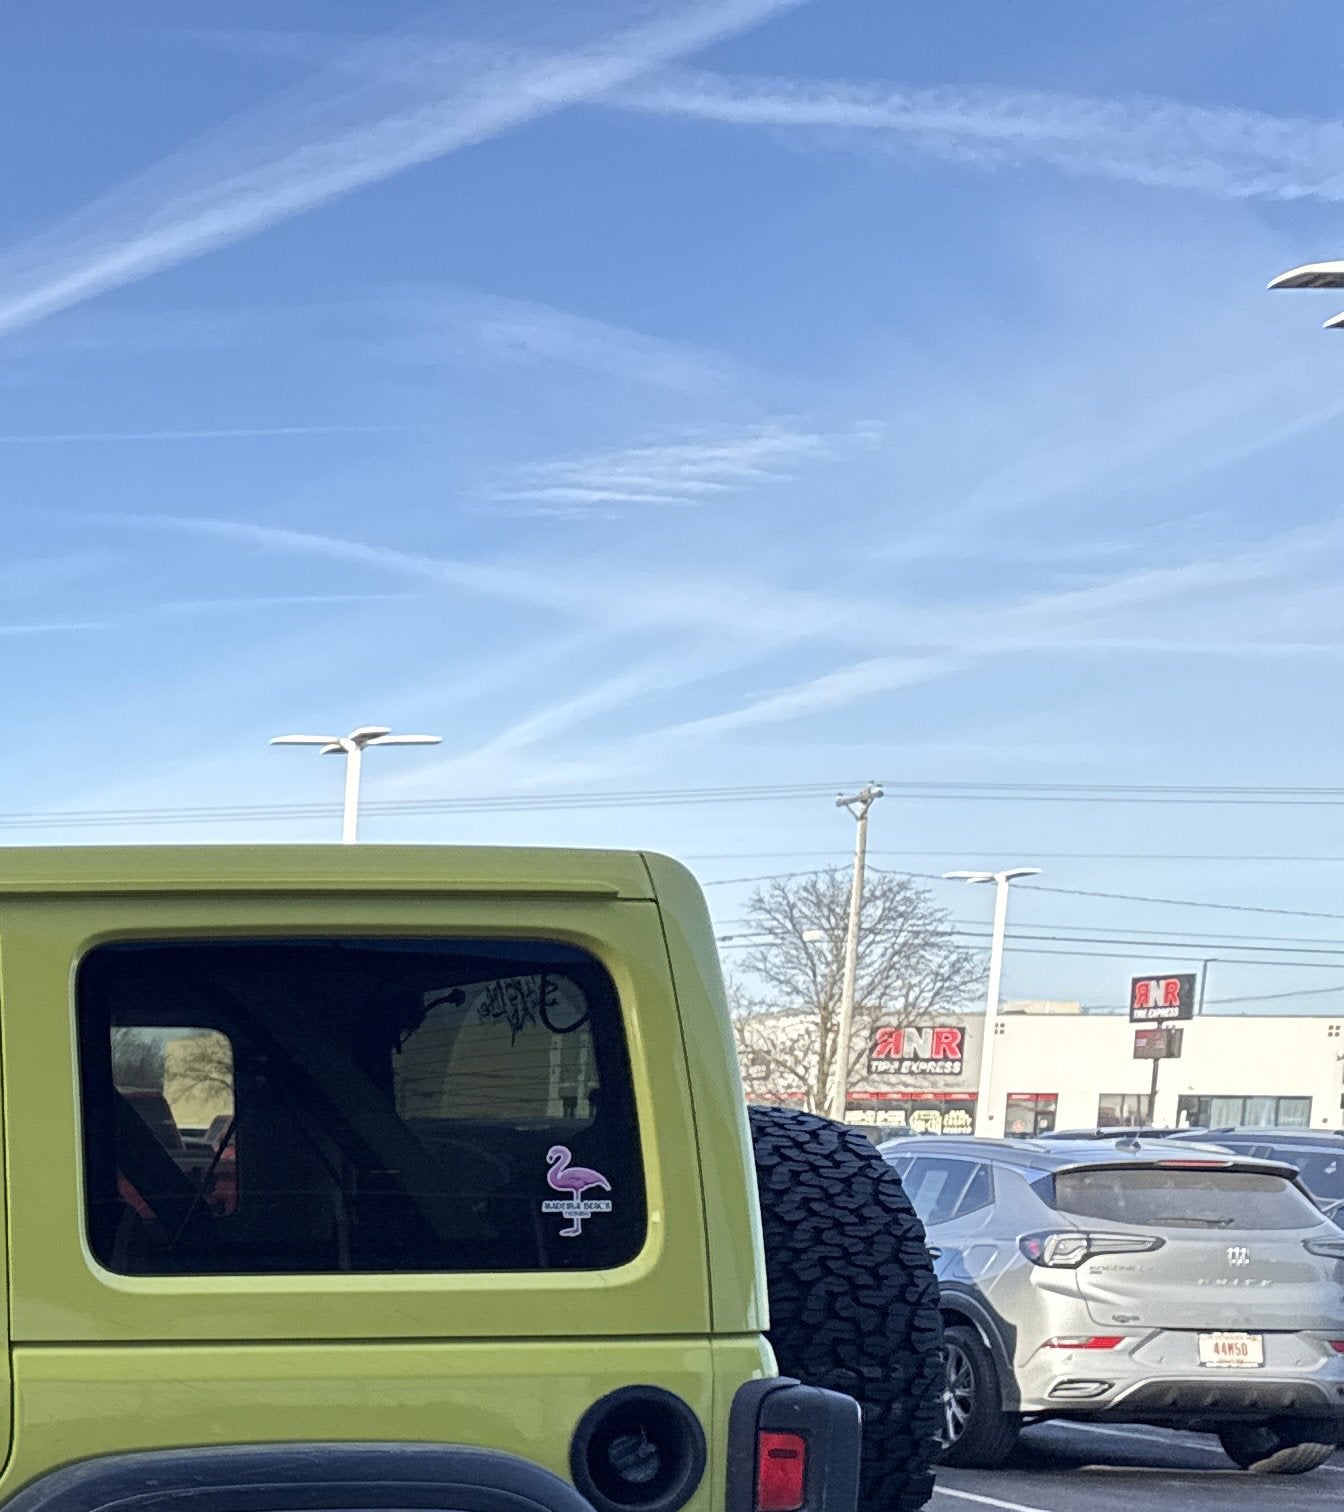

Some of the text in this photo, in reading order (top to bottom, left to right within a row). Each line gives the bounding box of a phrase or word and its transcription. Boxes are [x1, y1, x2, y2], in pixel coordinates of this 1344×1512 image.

[1134, 978, 1181, 1009] RNR
[872, 1027, 962, 1060] RNR
[900, 1061, 962, 1074] EXPRESS
